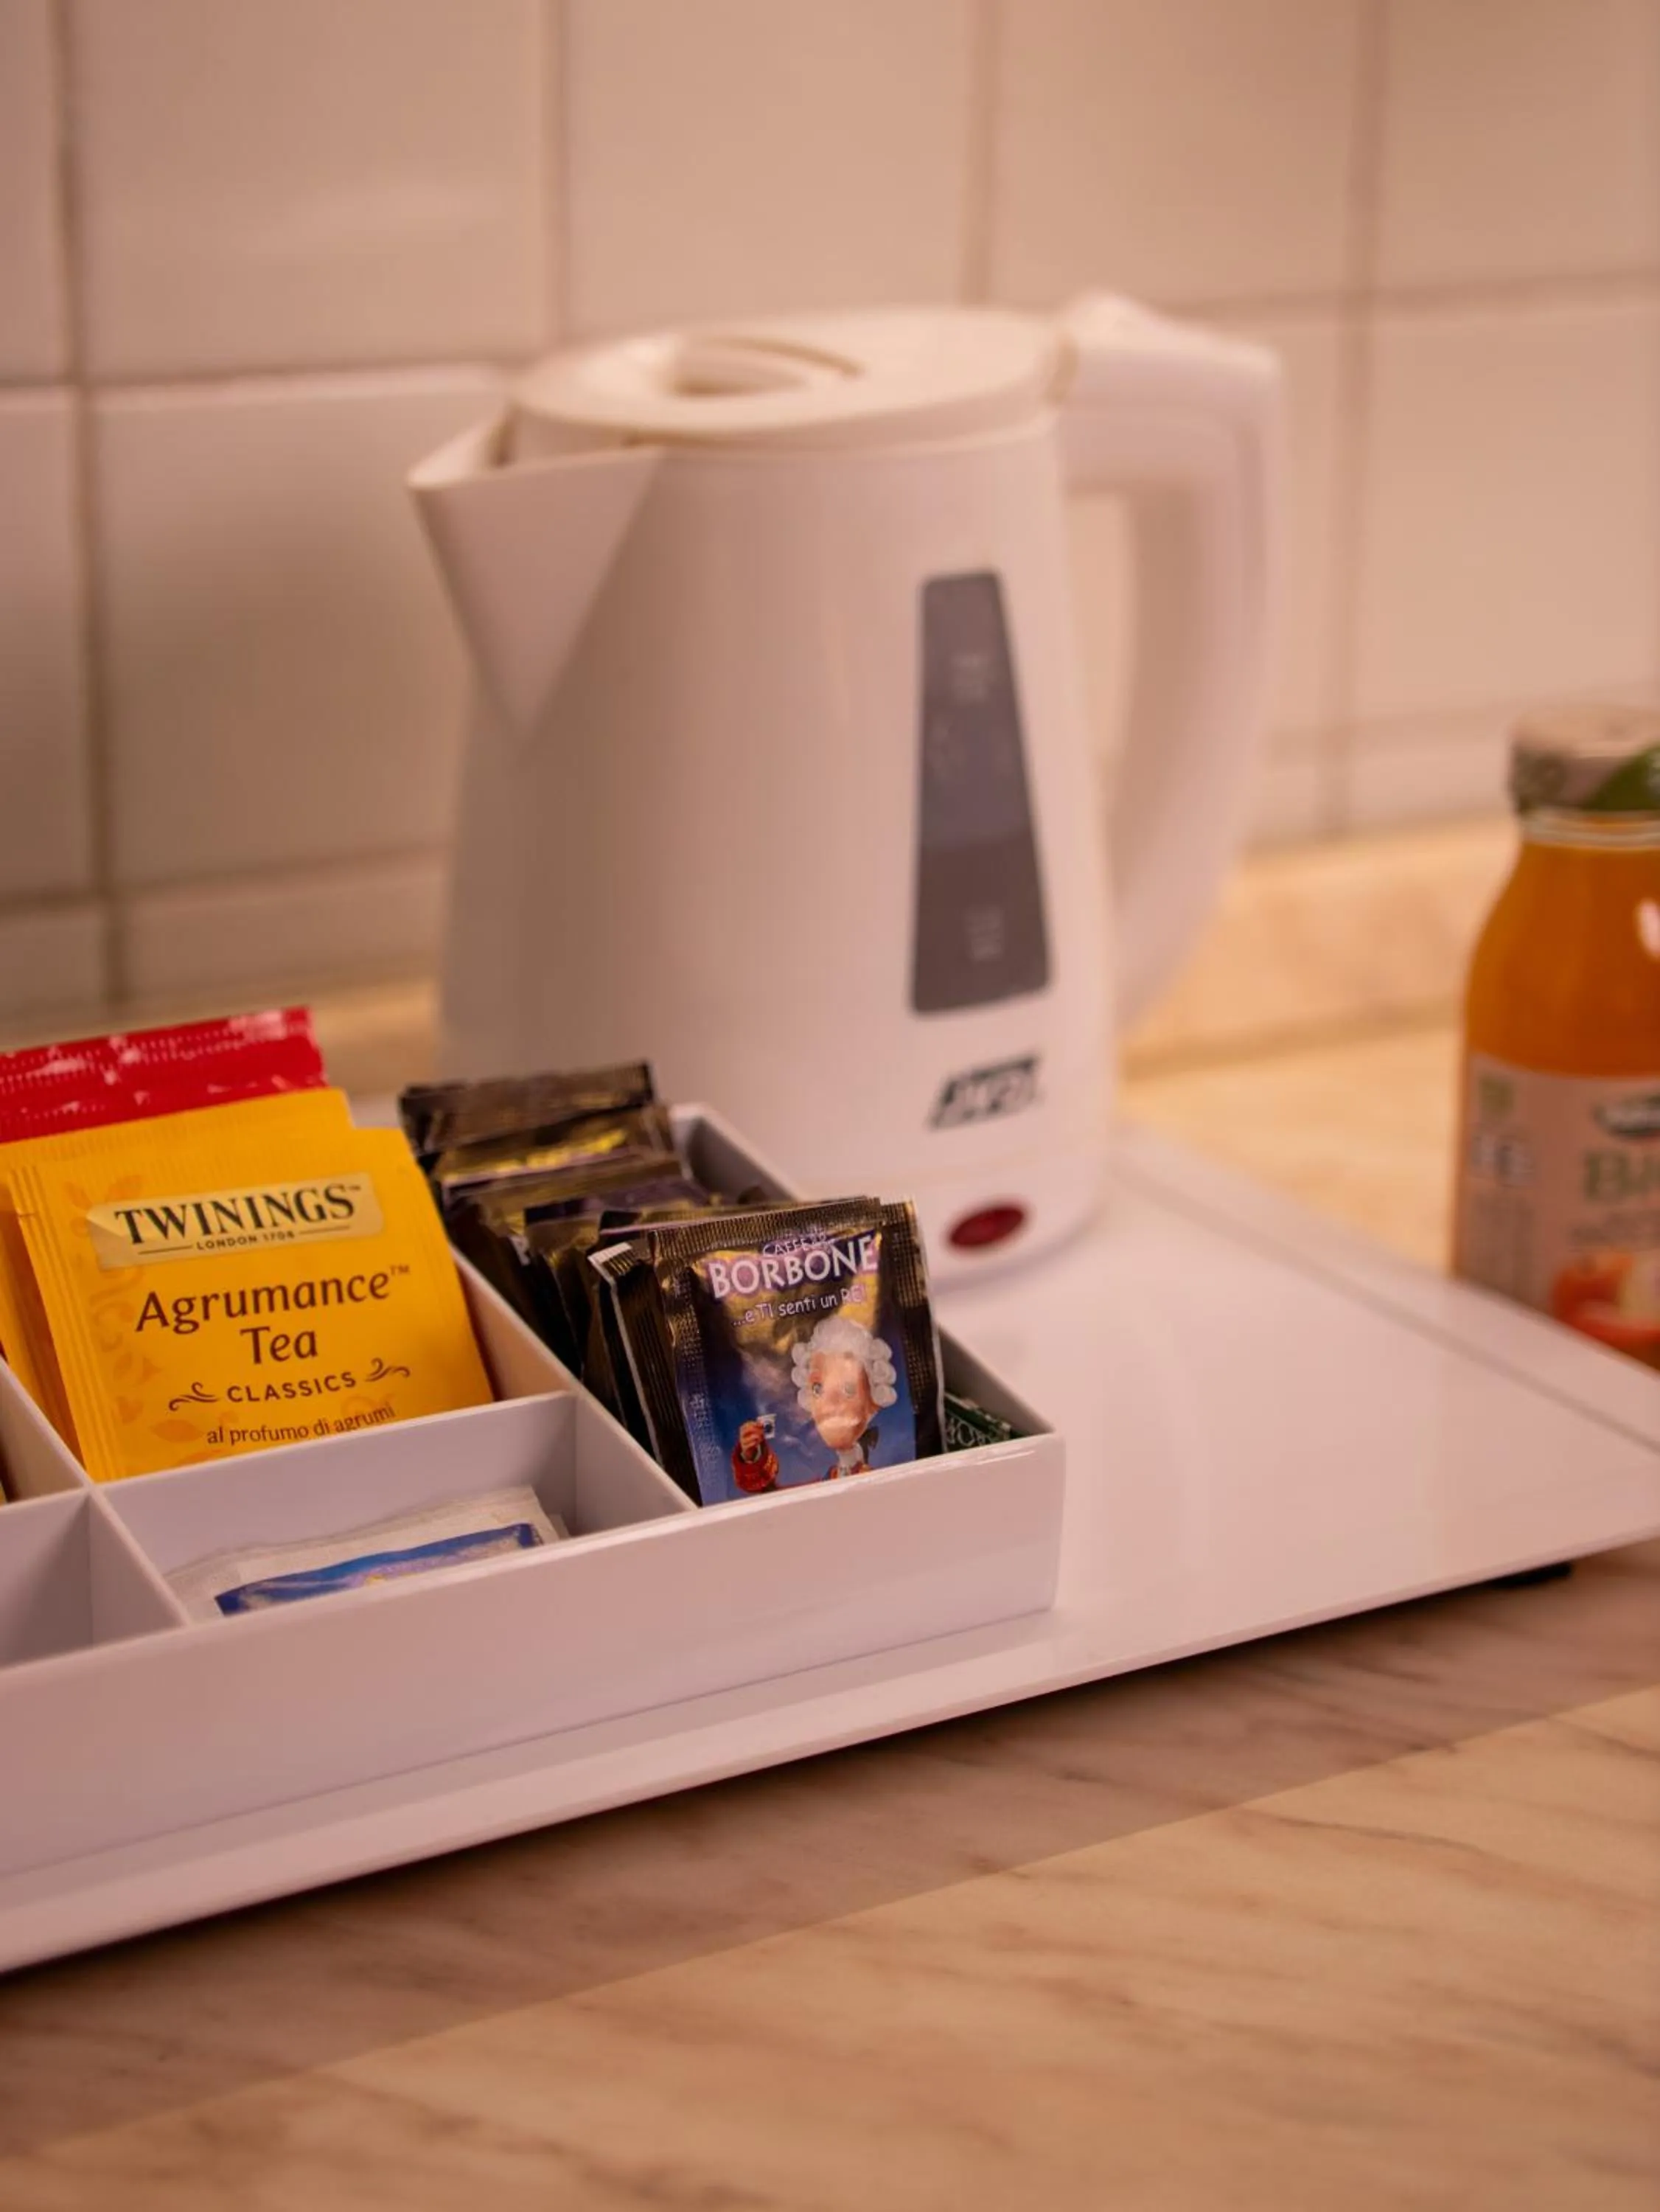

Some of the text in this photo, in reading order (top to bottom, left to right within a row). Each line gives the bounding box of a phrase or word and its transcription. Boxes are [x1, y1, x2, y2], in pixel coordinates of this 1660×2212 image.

[197, 1235, 258, 1251] LONDON
[708, 1235, 878, 1298] BORBONE
[778, 1297, 815, 1316] senti
[820, 1294, 838, 1309] un
[240, 1326, 318, 1365] Tea
[226, 1371, 357, 1402] CLASSICS
[207, 1400, 396, 1446] al profumo di agrumi
